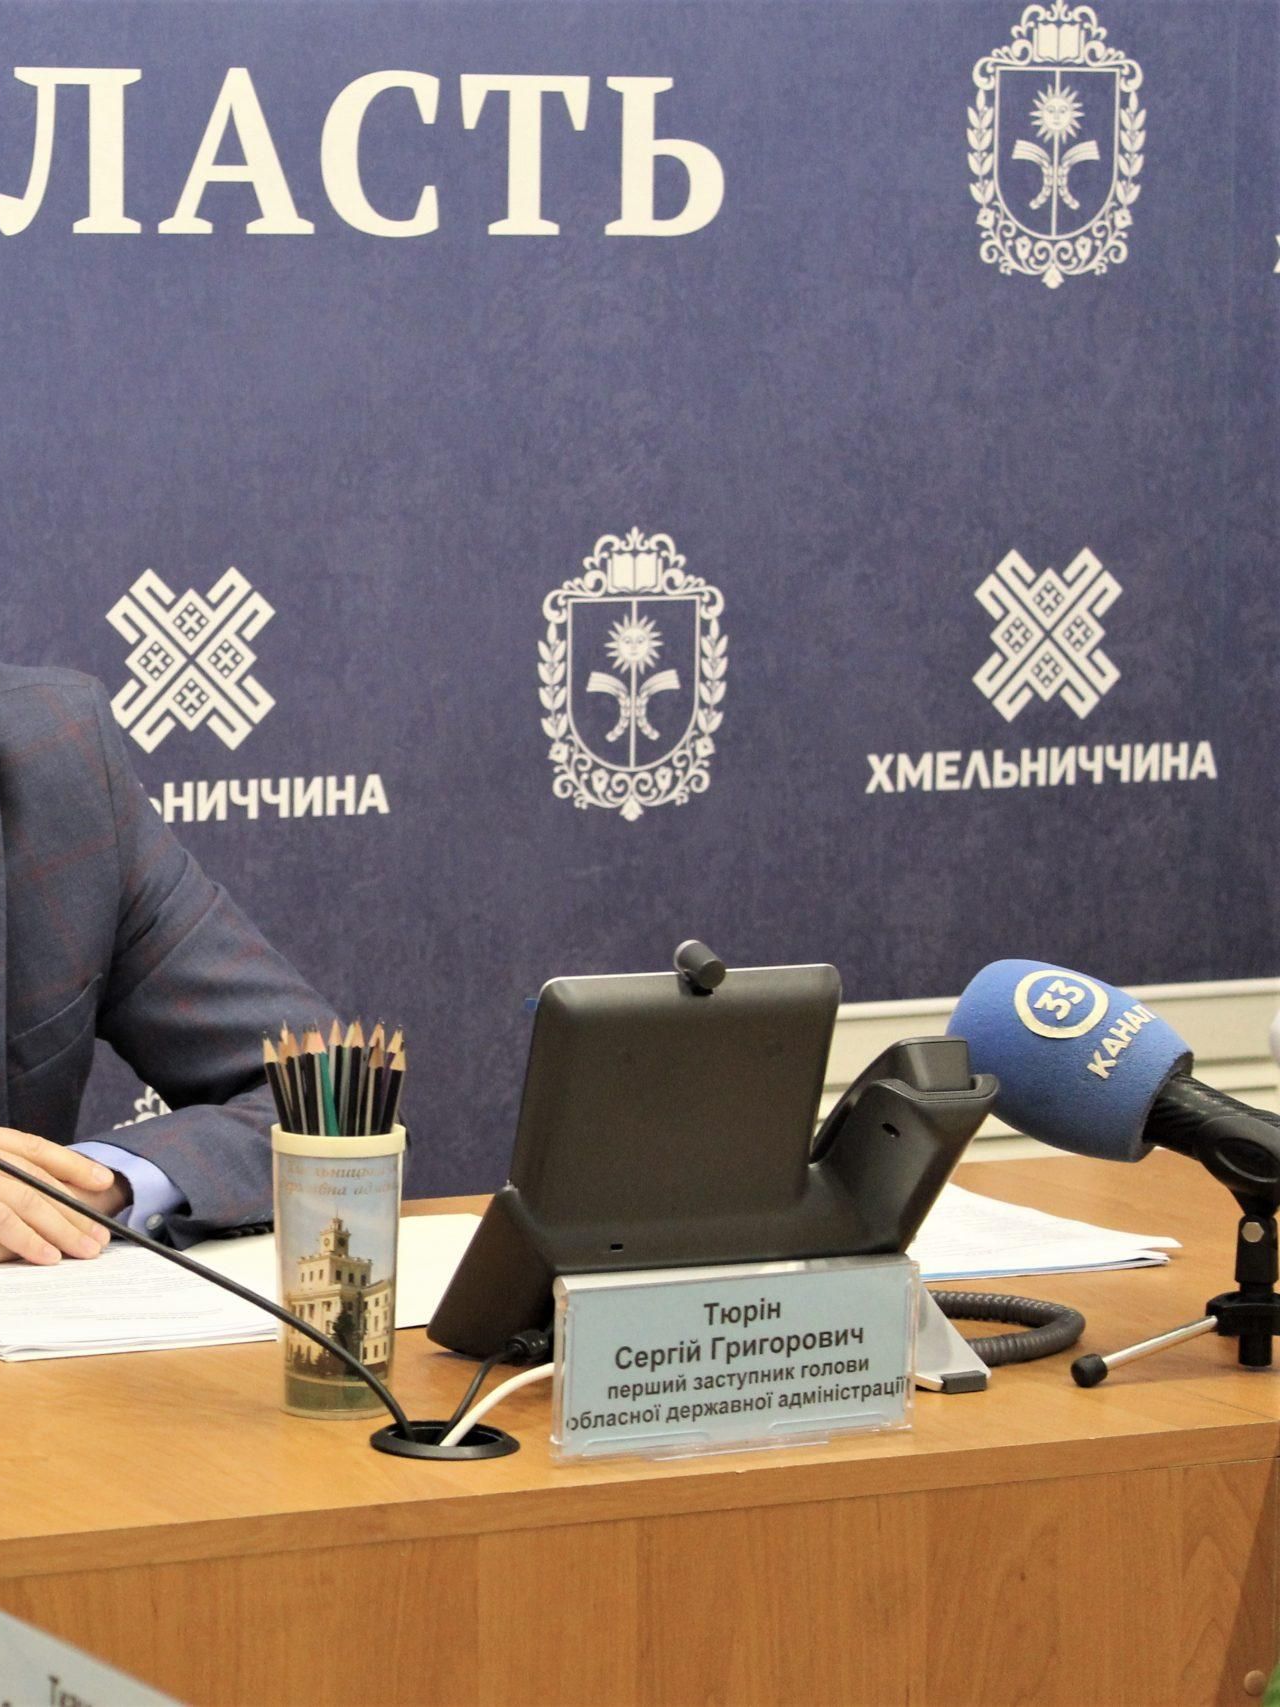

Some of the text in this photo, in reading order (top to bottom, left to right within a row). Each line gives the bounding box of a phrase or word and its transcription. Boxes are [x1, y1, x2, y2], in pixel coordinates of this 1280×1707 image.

[865, 740, 1218, 795] ХМЕЛЬНИЧЧИНА
[149, 773, 391, 823] НИЧЧИНА
[1033, 979, 1086, 1021] 33
[704, 1298, 782, 1328] Тюрін
[614, 1327, 865, 1372] Сергій Григорович
[607, 1357, 870, 1402] перший заступник голови
[566, 1376, 906, 1431] обласної державної адміністрації
